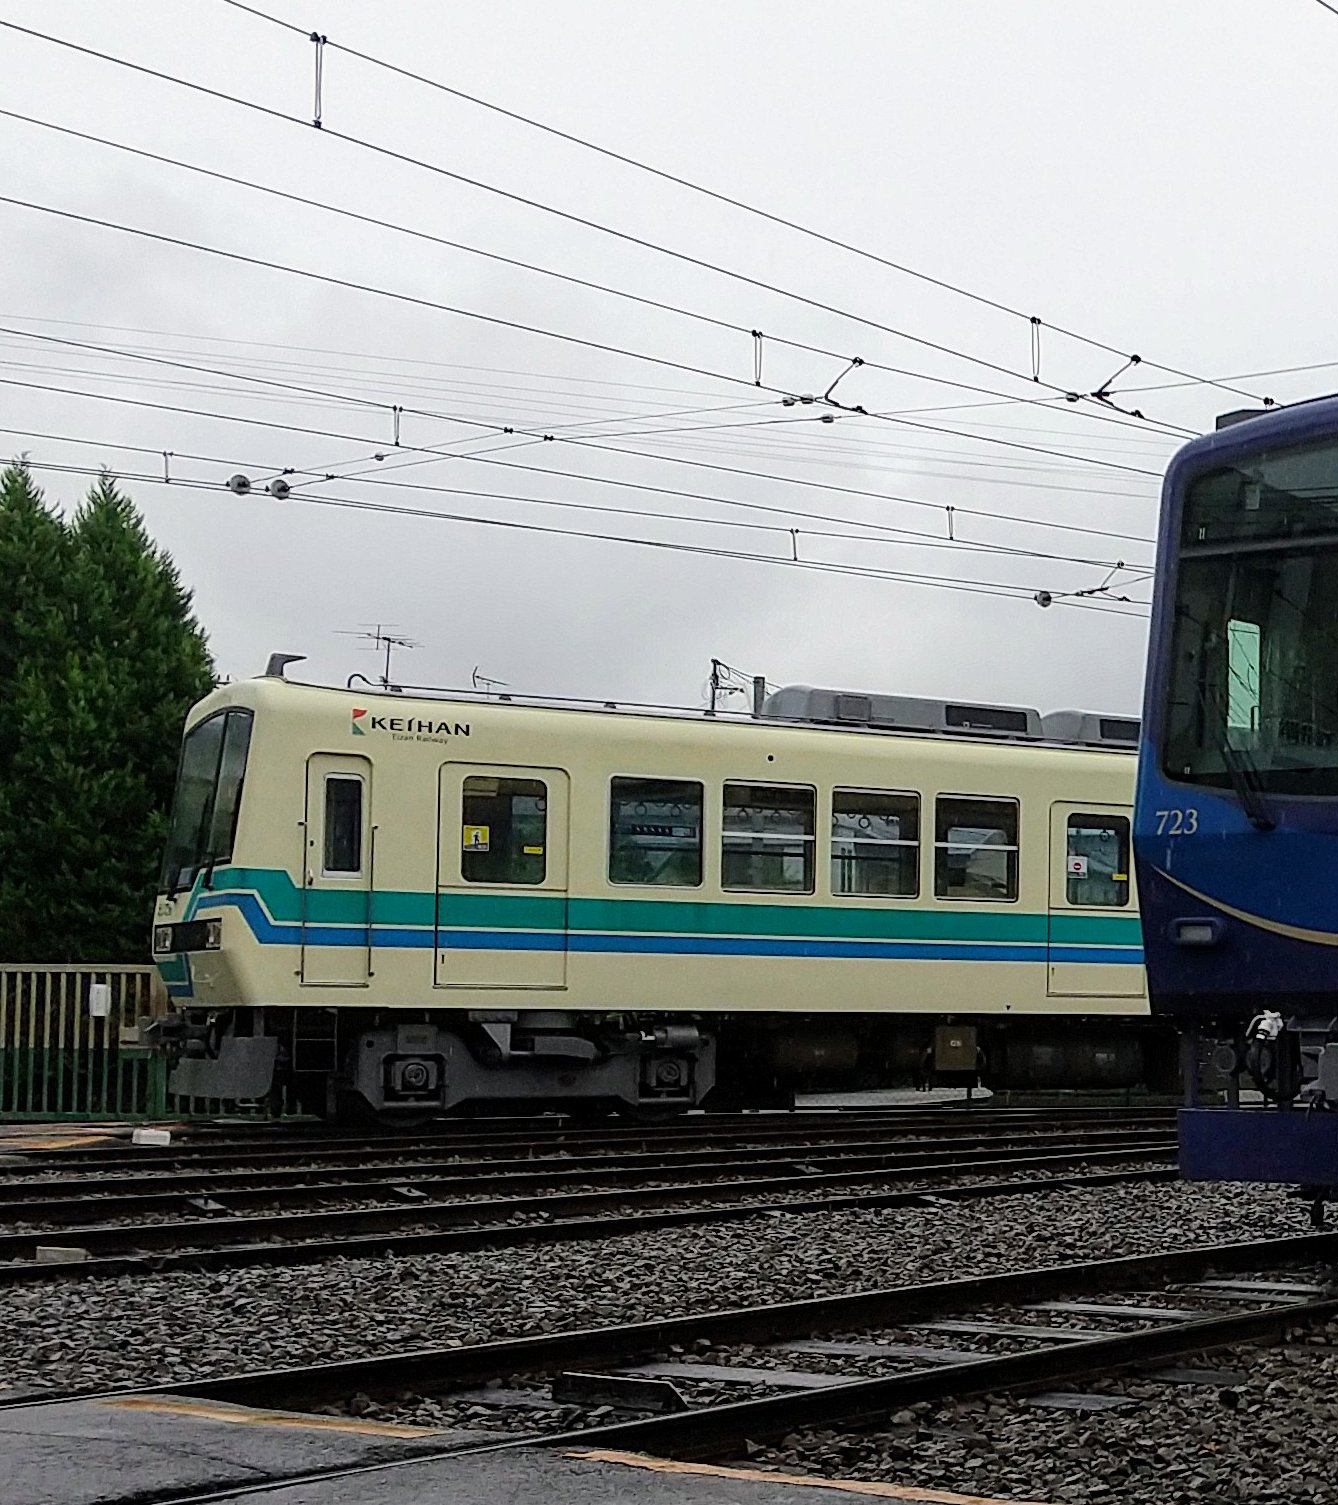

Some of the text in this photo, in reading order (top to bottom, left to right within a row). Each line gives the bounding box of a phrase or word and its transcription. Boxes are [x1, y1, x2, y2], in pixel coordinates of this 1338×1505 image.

[371, 716, 470, 737] KEIHAN
[392, 733, 414, 741] Eizan
[1155, 808, 1198, 836] 723
